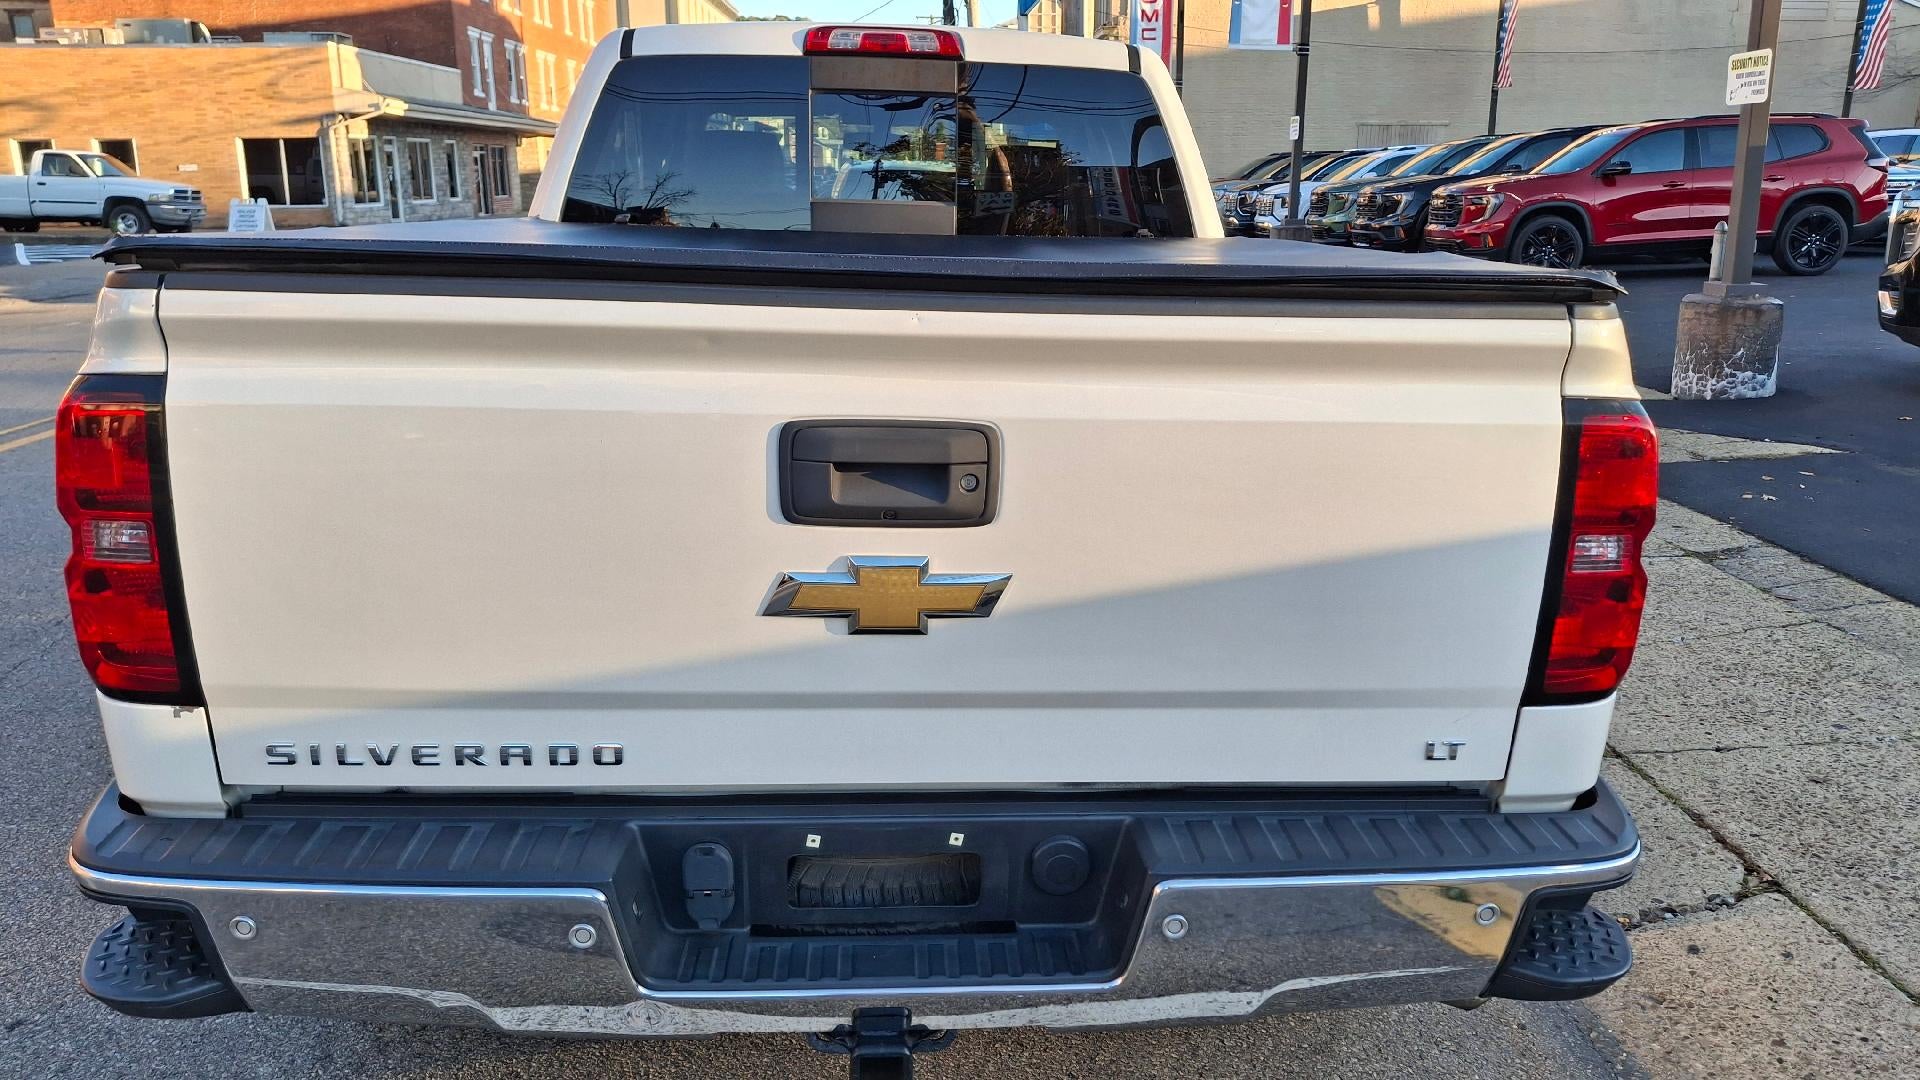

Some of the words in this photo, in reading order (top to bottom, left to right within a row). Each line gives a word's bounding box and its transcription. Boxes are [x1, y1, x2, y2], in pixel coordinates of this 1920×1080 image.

[1731, 56, 1752, 71] SECURITY
[1752, 55, 1769, 68] NOTICE
[265, 743, 624, 766] SILVERADO
[1425, 741, 1466, 761] LT
